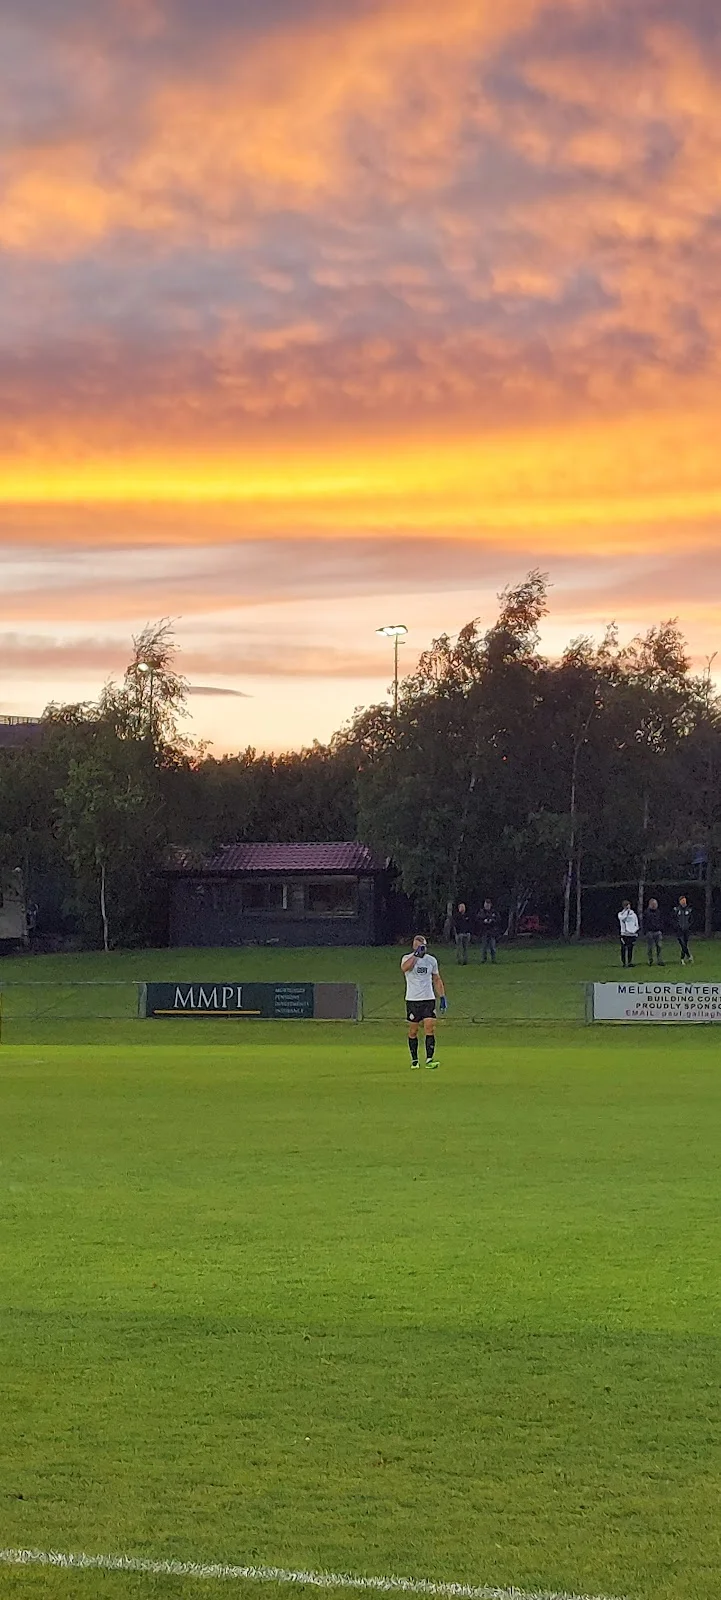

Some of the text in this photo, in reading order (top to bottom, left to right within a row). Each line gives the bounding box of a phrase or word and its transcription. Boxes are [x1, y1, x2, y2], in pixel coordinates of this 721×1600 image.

[173, 986, 242, 1008] MMPI
[618, 985, 719, 994] MELLOR ENTER
